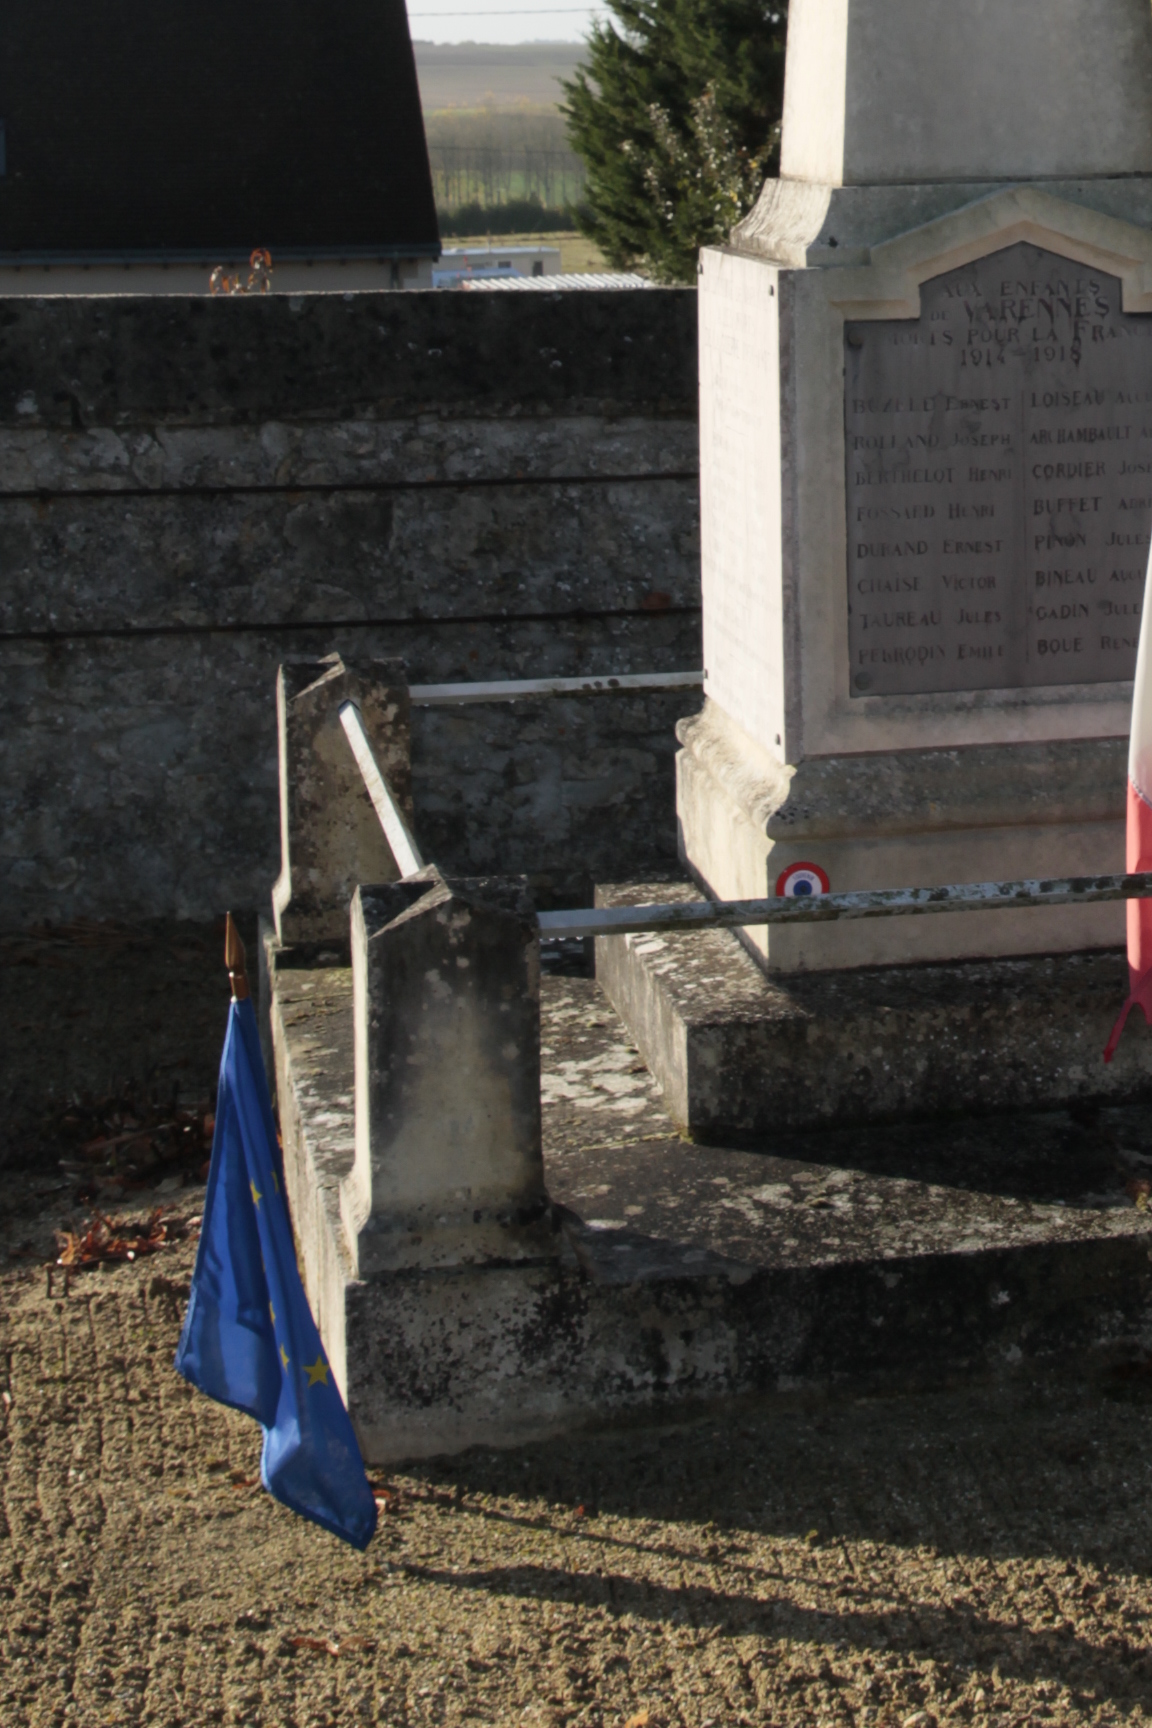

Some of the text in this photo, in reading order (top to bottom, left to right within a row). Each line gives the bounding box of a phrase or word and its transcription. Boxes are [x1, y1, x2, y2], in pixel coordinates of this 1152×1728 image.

[942, 279, 1100, 298] AUX ENFANTS
[930, 296, 1110, 322] DE VARENNES
[967, 327, 1019, 345] POUR
[1032, 327, 1058, 343] LA
[961, 348, 1005, 366] 1914
[1033, 346, 1081, 365] 1918
[945, 397, 1011, 411] ERNEST
[1031, 390, 1105, 408] LOISEAU
[952, 433, 1011, 447] JOSEPH
[1030, 426, 1132, 444] ARCHAMBAULT
[856, 467, 1012, 485] BERTHELOT HENRI
[1032, 461, 1106, 480] CORDIER
[857, 503, 994, 521] FOSSARD HENRI
[1033, 497, 1103, 515] BUFFET
[857, 539, 1003, 558] DURAND ERNEST
[857, 575, 996, 594] CHAISE VICTOR
[1035, 568, 1096, 587] BINEAU
[860, 609, 1001, 629] TAUREAU JULES
[1036, 603, 1089, 620] GADIN
[858, 644, 1004, 665] PERRODIN EMILE
